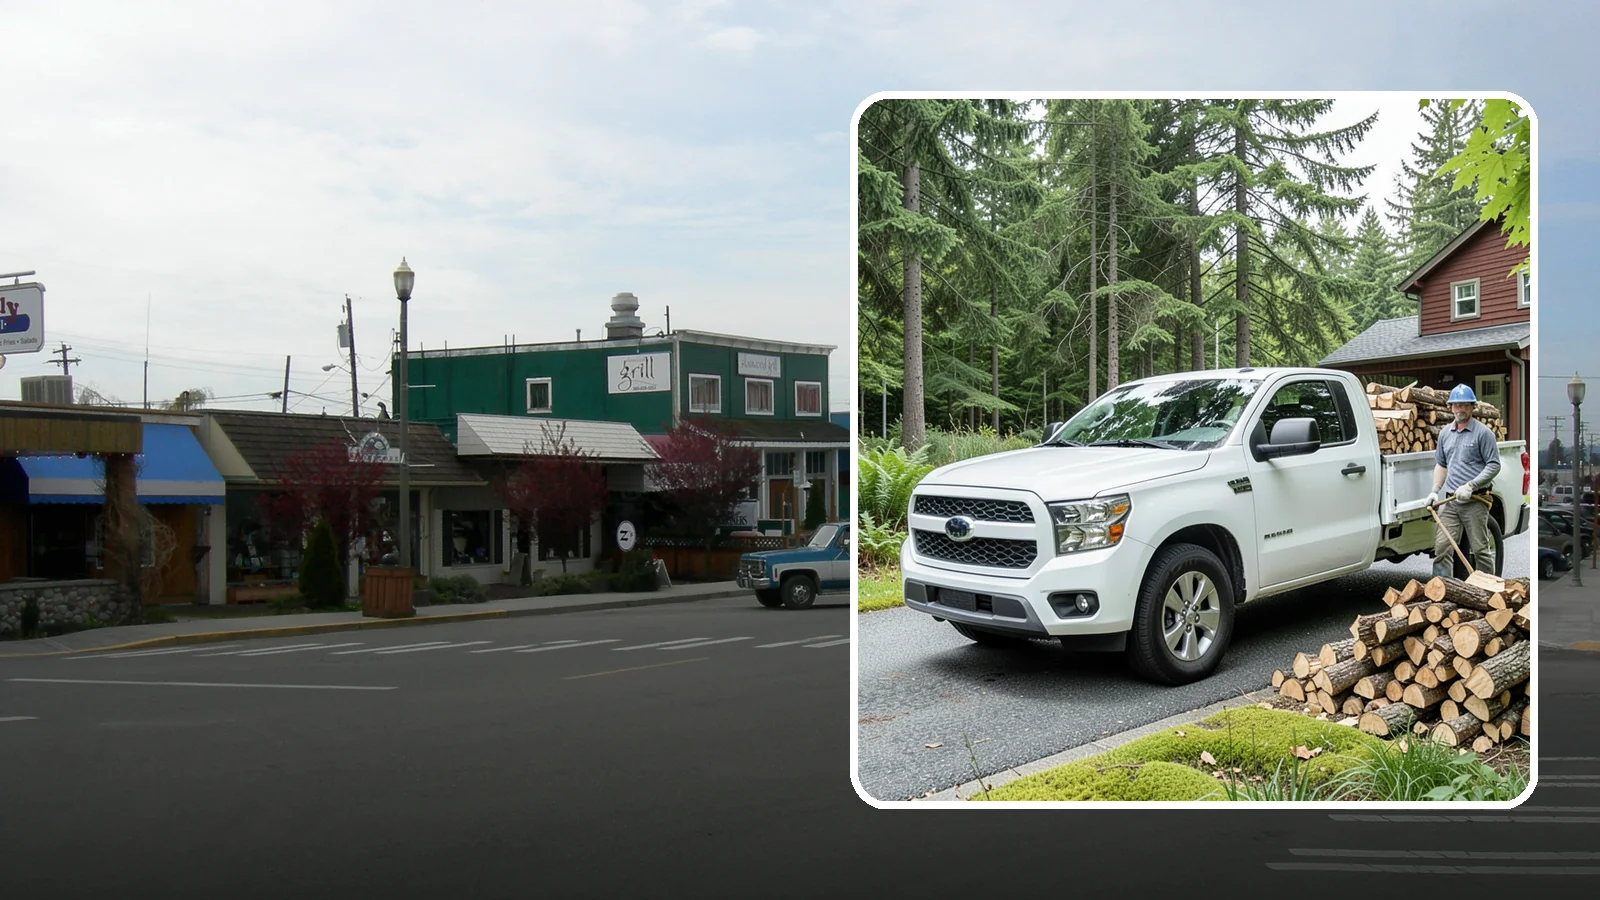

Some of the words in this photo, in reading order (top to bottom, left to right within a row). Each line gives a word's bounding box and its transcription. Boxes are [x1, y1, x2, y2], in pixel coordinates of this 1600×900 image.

[3, 338, 16, 346] Fries
[20, 337, 38, 345] Salads
[618, 355, 655, 391] grill
